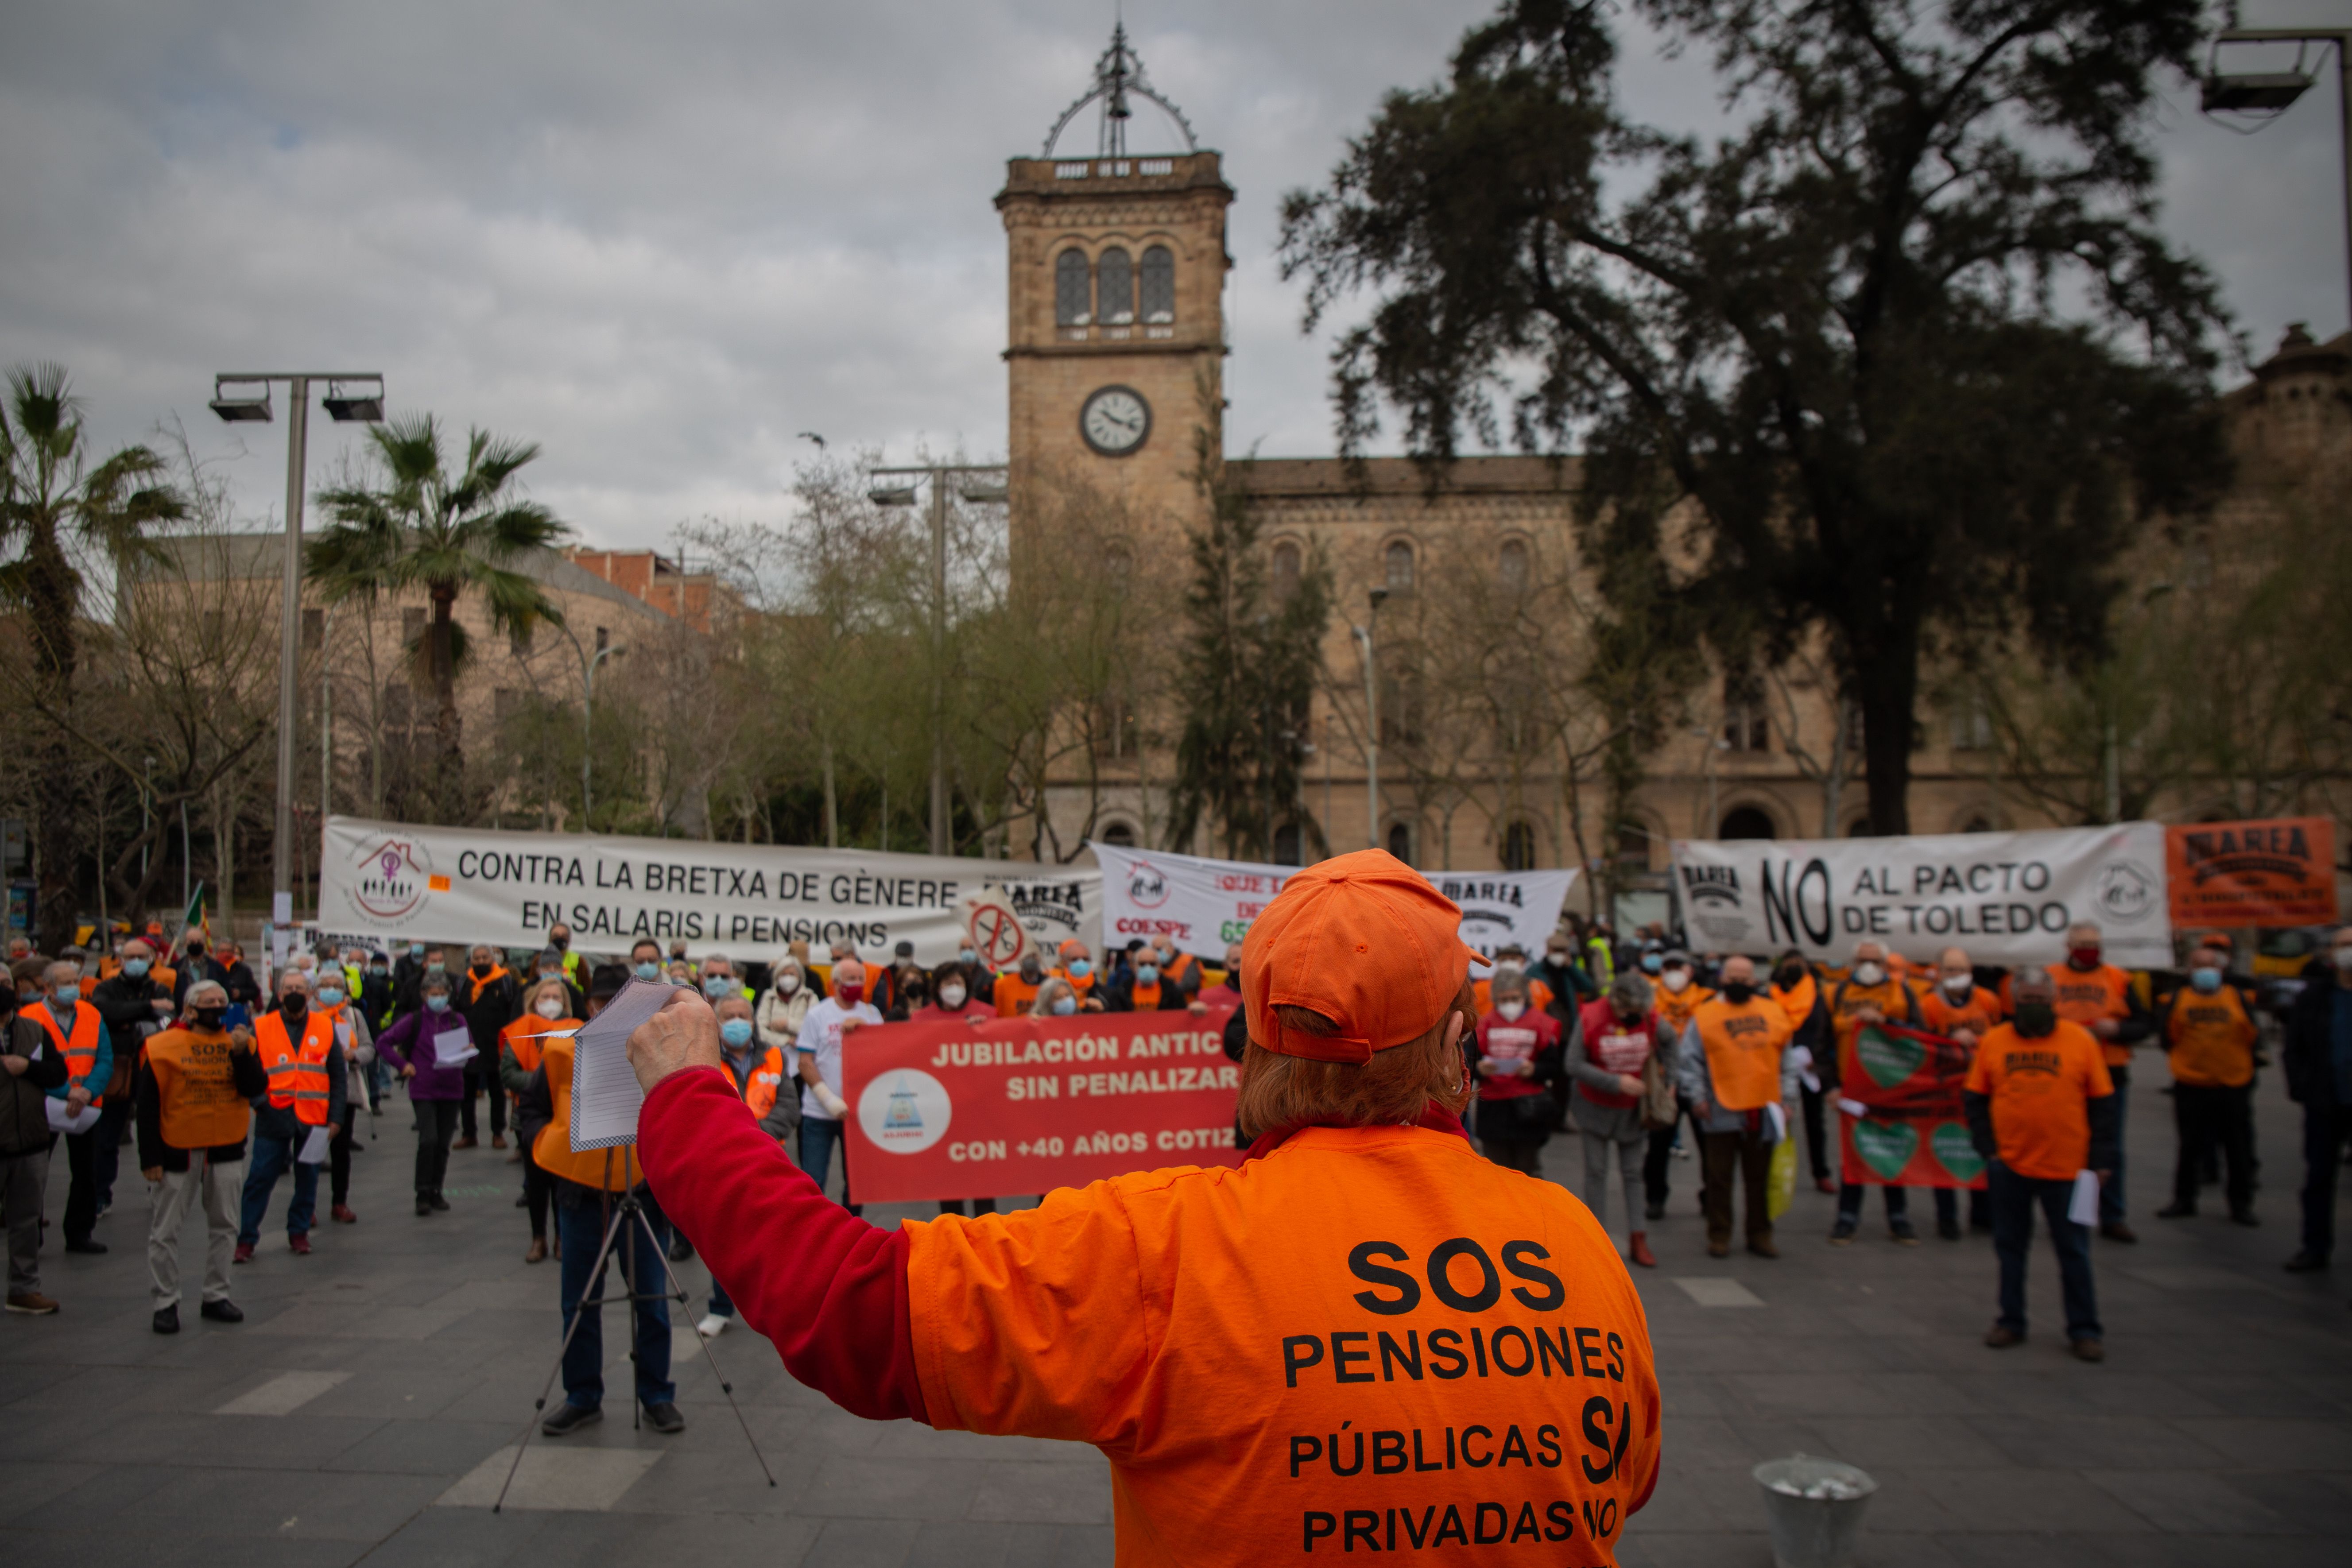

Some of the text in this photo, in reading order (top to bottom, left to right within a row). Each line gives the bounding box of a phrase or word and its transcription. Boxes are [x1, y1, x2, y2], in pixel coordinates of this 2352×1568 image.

[459, 850, 585, 886] CONTRA
[597, 859, 634, 890] LA
[645, 863, 768, 899] BRETXA
[779, 871, 820, 902] DE
[830, 867, 959, 909] GÈNERE
[984, 883, 1083, 912] AREA
[1852, 866, 1901, 896] AL
[1914, 861, 2051, 894] PACTO
[1762, 857, 1833, 946] NO
[1842, 902, 2070, 935] DE TOLEDO
[522, 900, 888, 947] EN SALARIS I PENSIONS
[1116, 918, 1192, 941] COESPE
[931, 1030, 1222, 1067] JUBILACIÓN ANTIC
[1006, 1065, 1240, 1100] SIN PENALIZAR
[948, 1127, 1236, 1162] CON +40 AÑOS COTIZ
[1348, 1237, 1566, 1316] SOS
[1282, 1325, 1624, 1388] PENSIONES
[1290, 1396, 1631, 1484] PÚBLICAS SI
[1303, 1498, 1616, 1553] PRIVADAS NO
